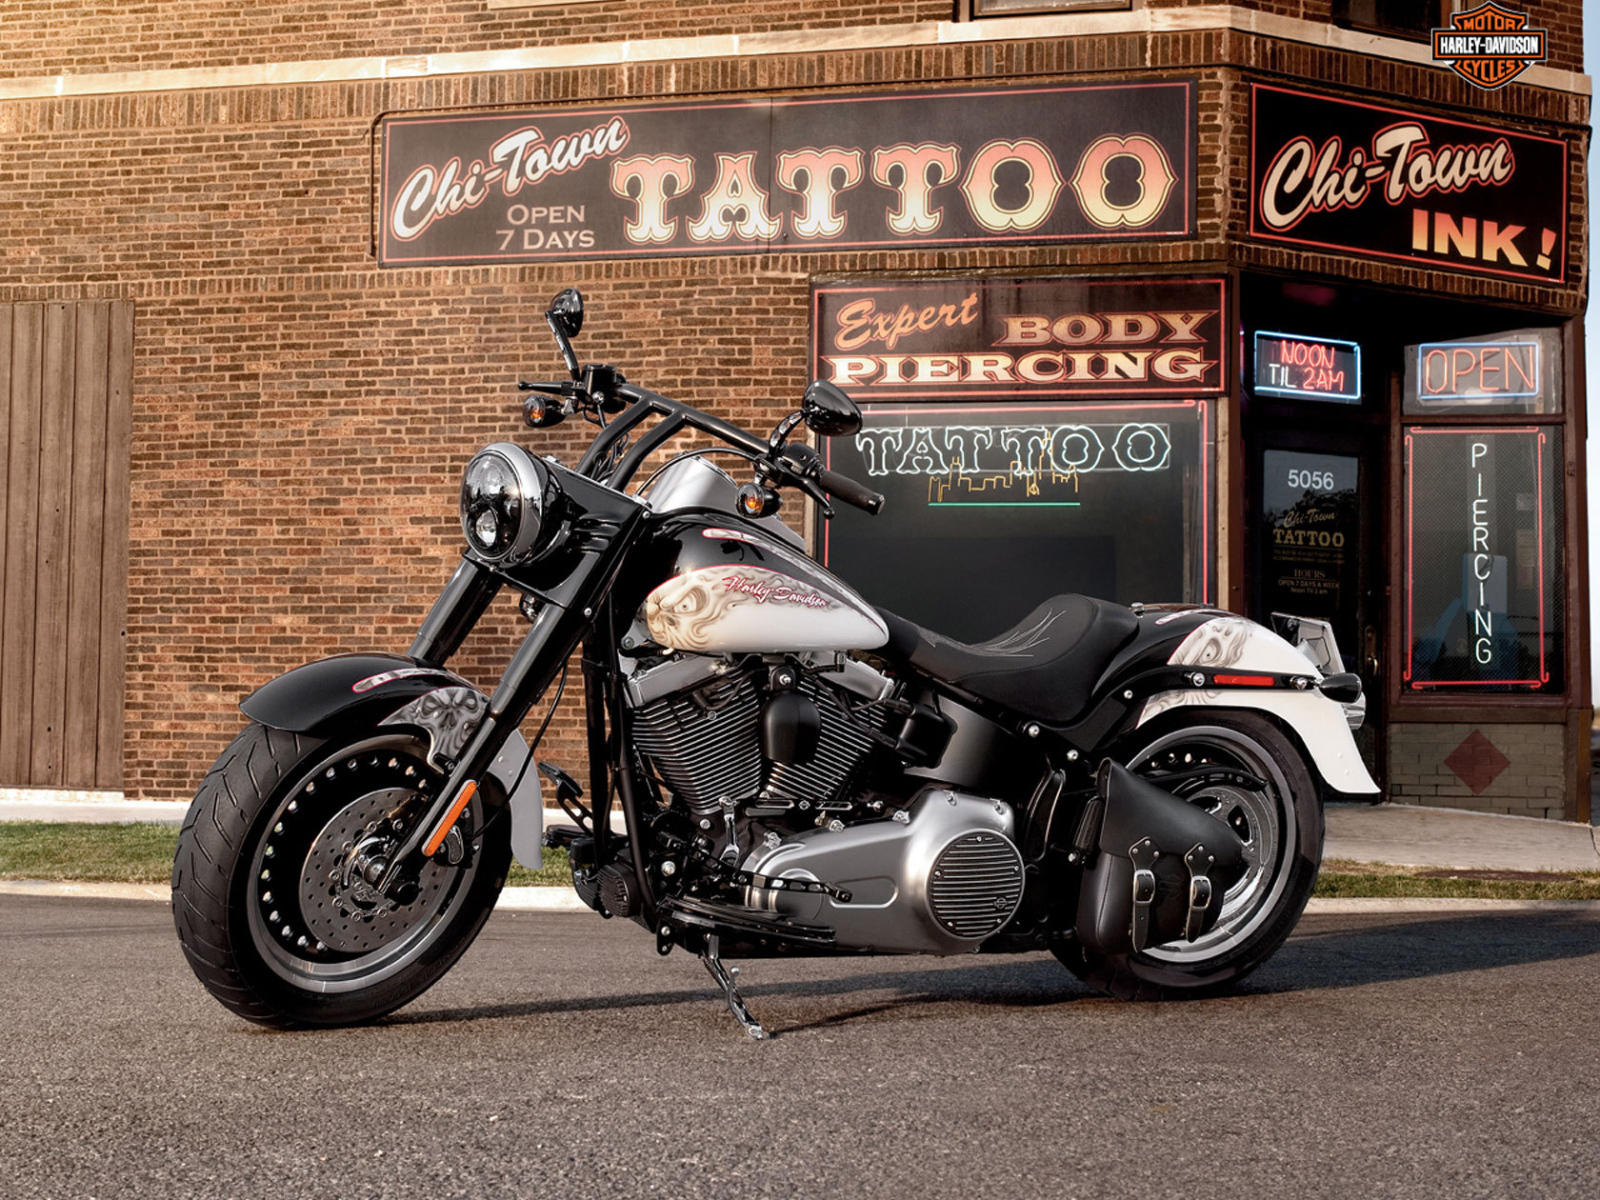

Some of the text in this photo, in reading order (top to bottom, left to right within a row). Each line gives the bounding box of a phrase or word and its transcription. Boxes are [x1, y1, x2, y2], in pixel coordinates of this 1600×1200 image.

[392, 116, 630, 241] Chi-Town
[610, 132, 1179, 245] TATTOO
[1260, 121, 1515, 231] Chi-Town
[507, 204, 585, 224] OPEN
[496, 228, 595, 250] 7 DAYS
[834, 292, 979, 351] Expert
[991, 309, 1219, 347] BODY
[821, 347, 1219, 386] PIERCING
[1269, 363, 1297, 388] TIL
[1425, 345, 1535, 393] OPEN
[1287, 469, 1334, 490] 5056
[1272, 528, 1345, 547] TATTOO
[1471, 443, 1492, 664] PIERCING
